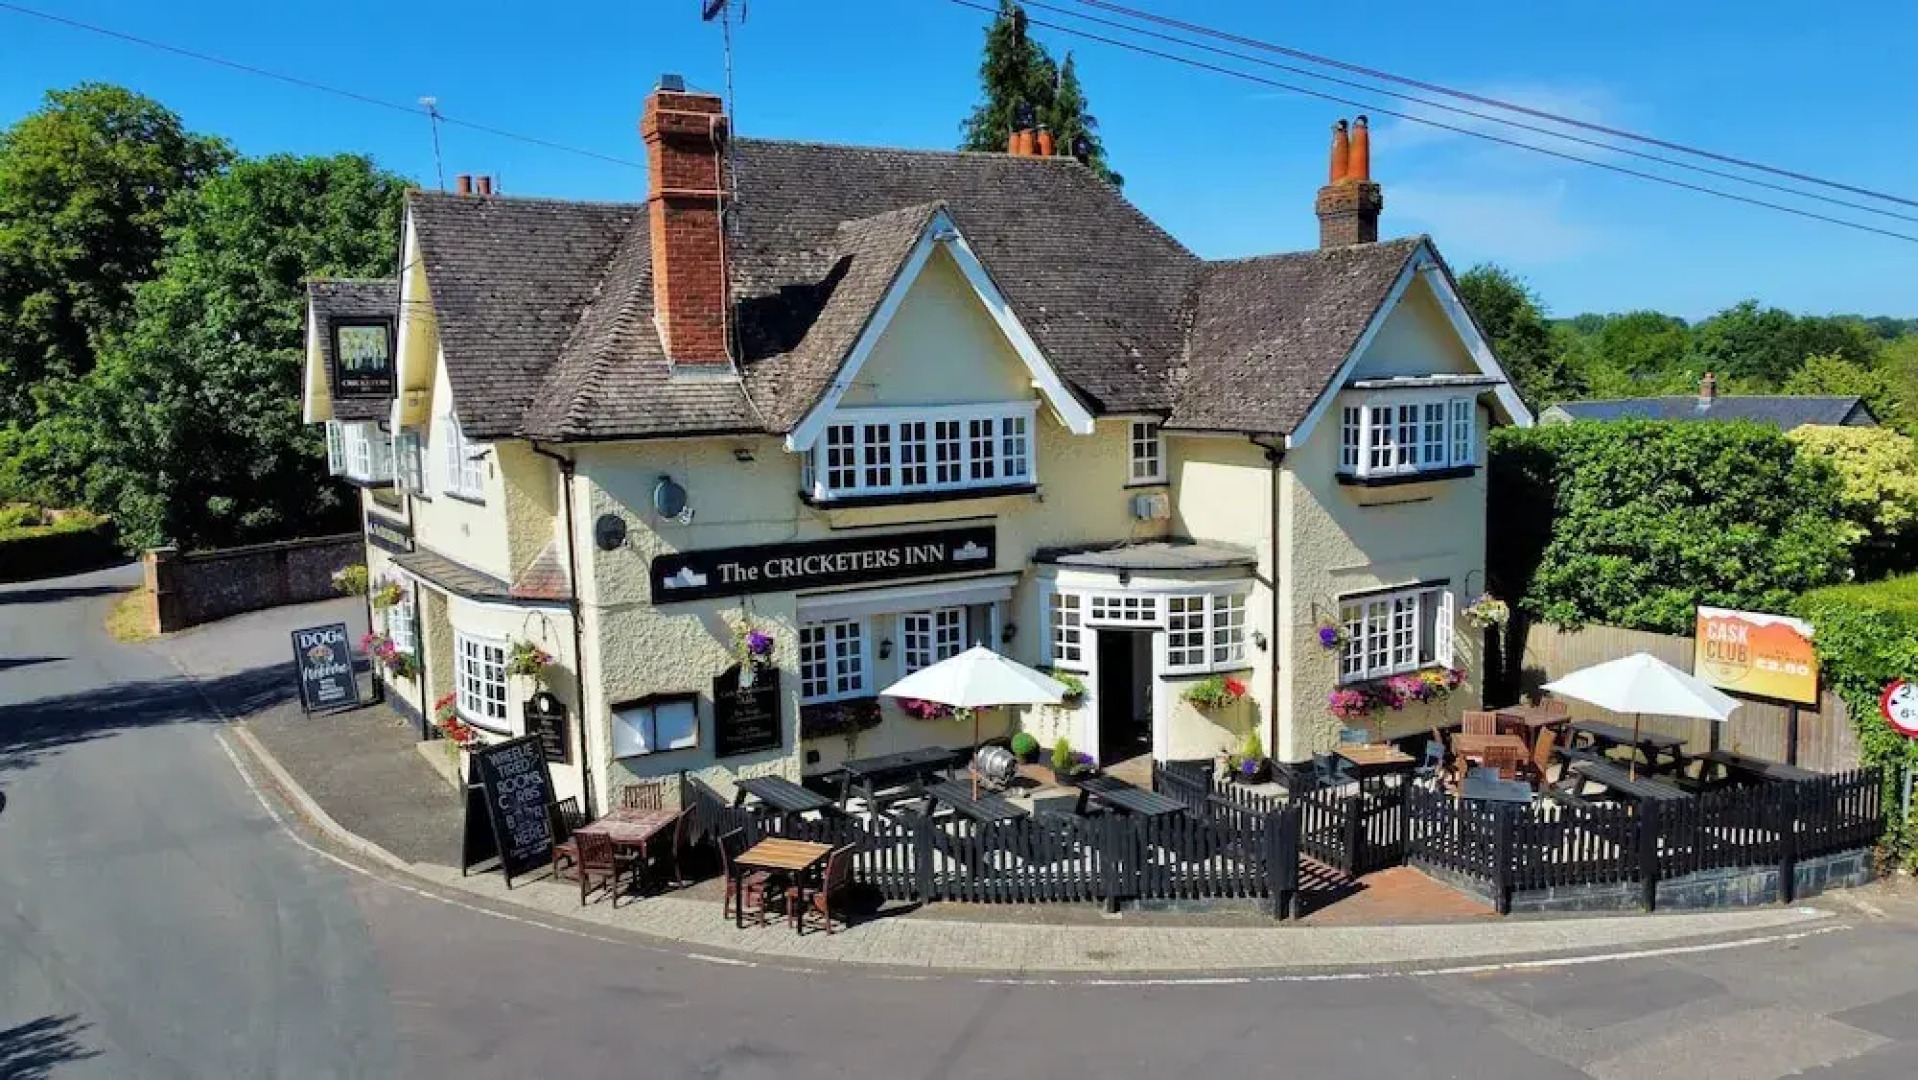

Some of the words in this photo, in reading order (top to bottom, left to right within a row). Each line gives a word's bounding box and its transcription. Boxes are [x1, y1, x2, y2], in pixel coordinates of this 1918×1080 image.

[718, 563, 758, 584] The
[763, 548, 900, 580] CRICKETERS
[904, 543, 946, 566] INN
[1706, 621, 1748, 646] CASK
[1706, 640, 1747, 663] CLUB
[499, 786, 541, 810] CRBS
